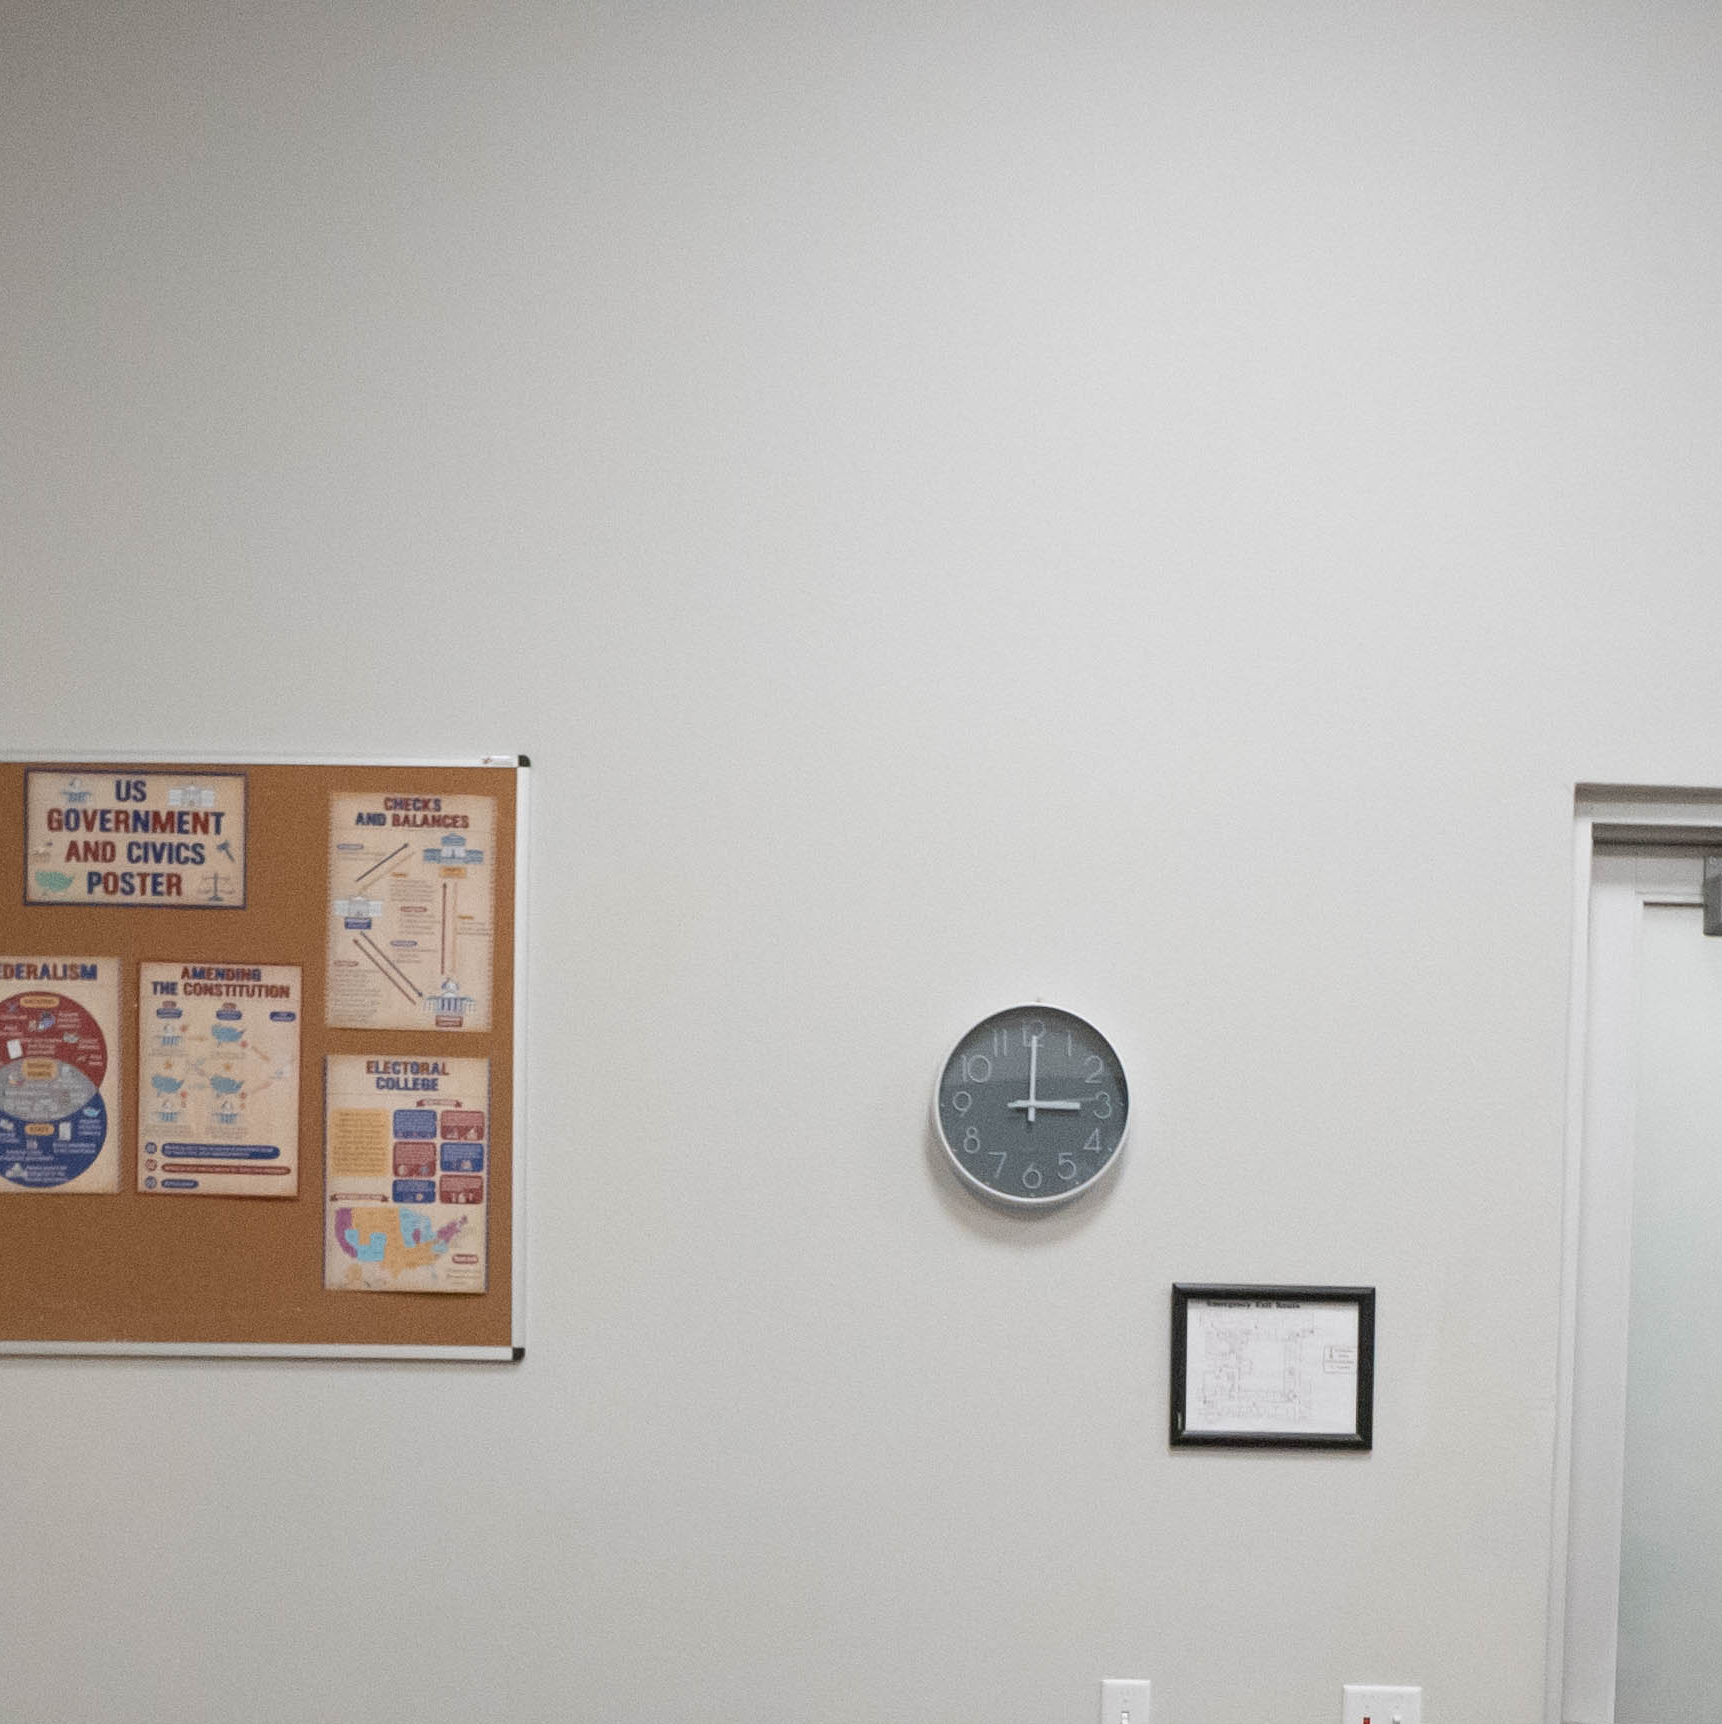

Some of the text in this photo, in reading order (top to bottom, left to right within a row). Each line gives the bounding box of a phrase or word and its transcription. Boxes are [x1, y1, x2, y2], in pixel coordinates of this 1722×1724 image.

[115, 779, 147, 802] US
[383, 797, 442, 812] CHECKS
[46, 808, 226, 836] GOVERNMENT
[355, 812, 470, 829] AND BALANCES
[64, 840, 206, 865] AND CIVICS
[86, 871, 183, 897] POSTER
[181, 966, 262, 982] AMENDING
[151, 981, 291, 999] THE CONSTITUTION
[993, 1029, 1008, 1057] 11
[1022, 1019, 1046, 1048] 12
[366, 1061, 451, 1076] ELECTORAL
[960, 1054, 993, 1083] 10
[1084, 1055, 1104, 1084] 2
[375, 1077, 440, 1091] COLLEGE
[952, 1090, 973, 1118] 9
[1092, 1091, 1113, 1119] 3
[963, 1126, 981, 1154] 8
[1083, 1127, 1103, 1154] 4
[988, 1151, 1008, 1178] 7
[1022, 1162, 1043, 1189] 6
[1057, 1152, 1077, 1180] 5
